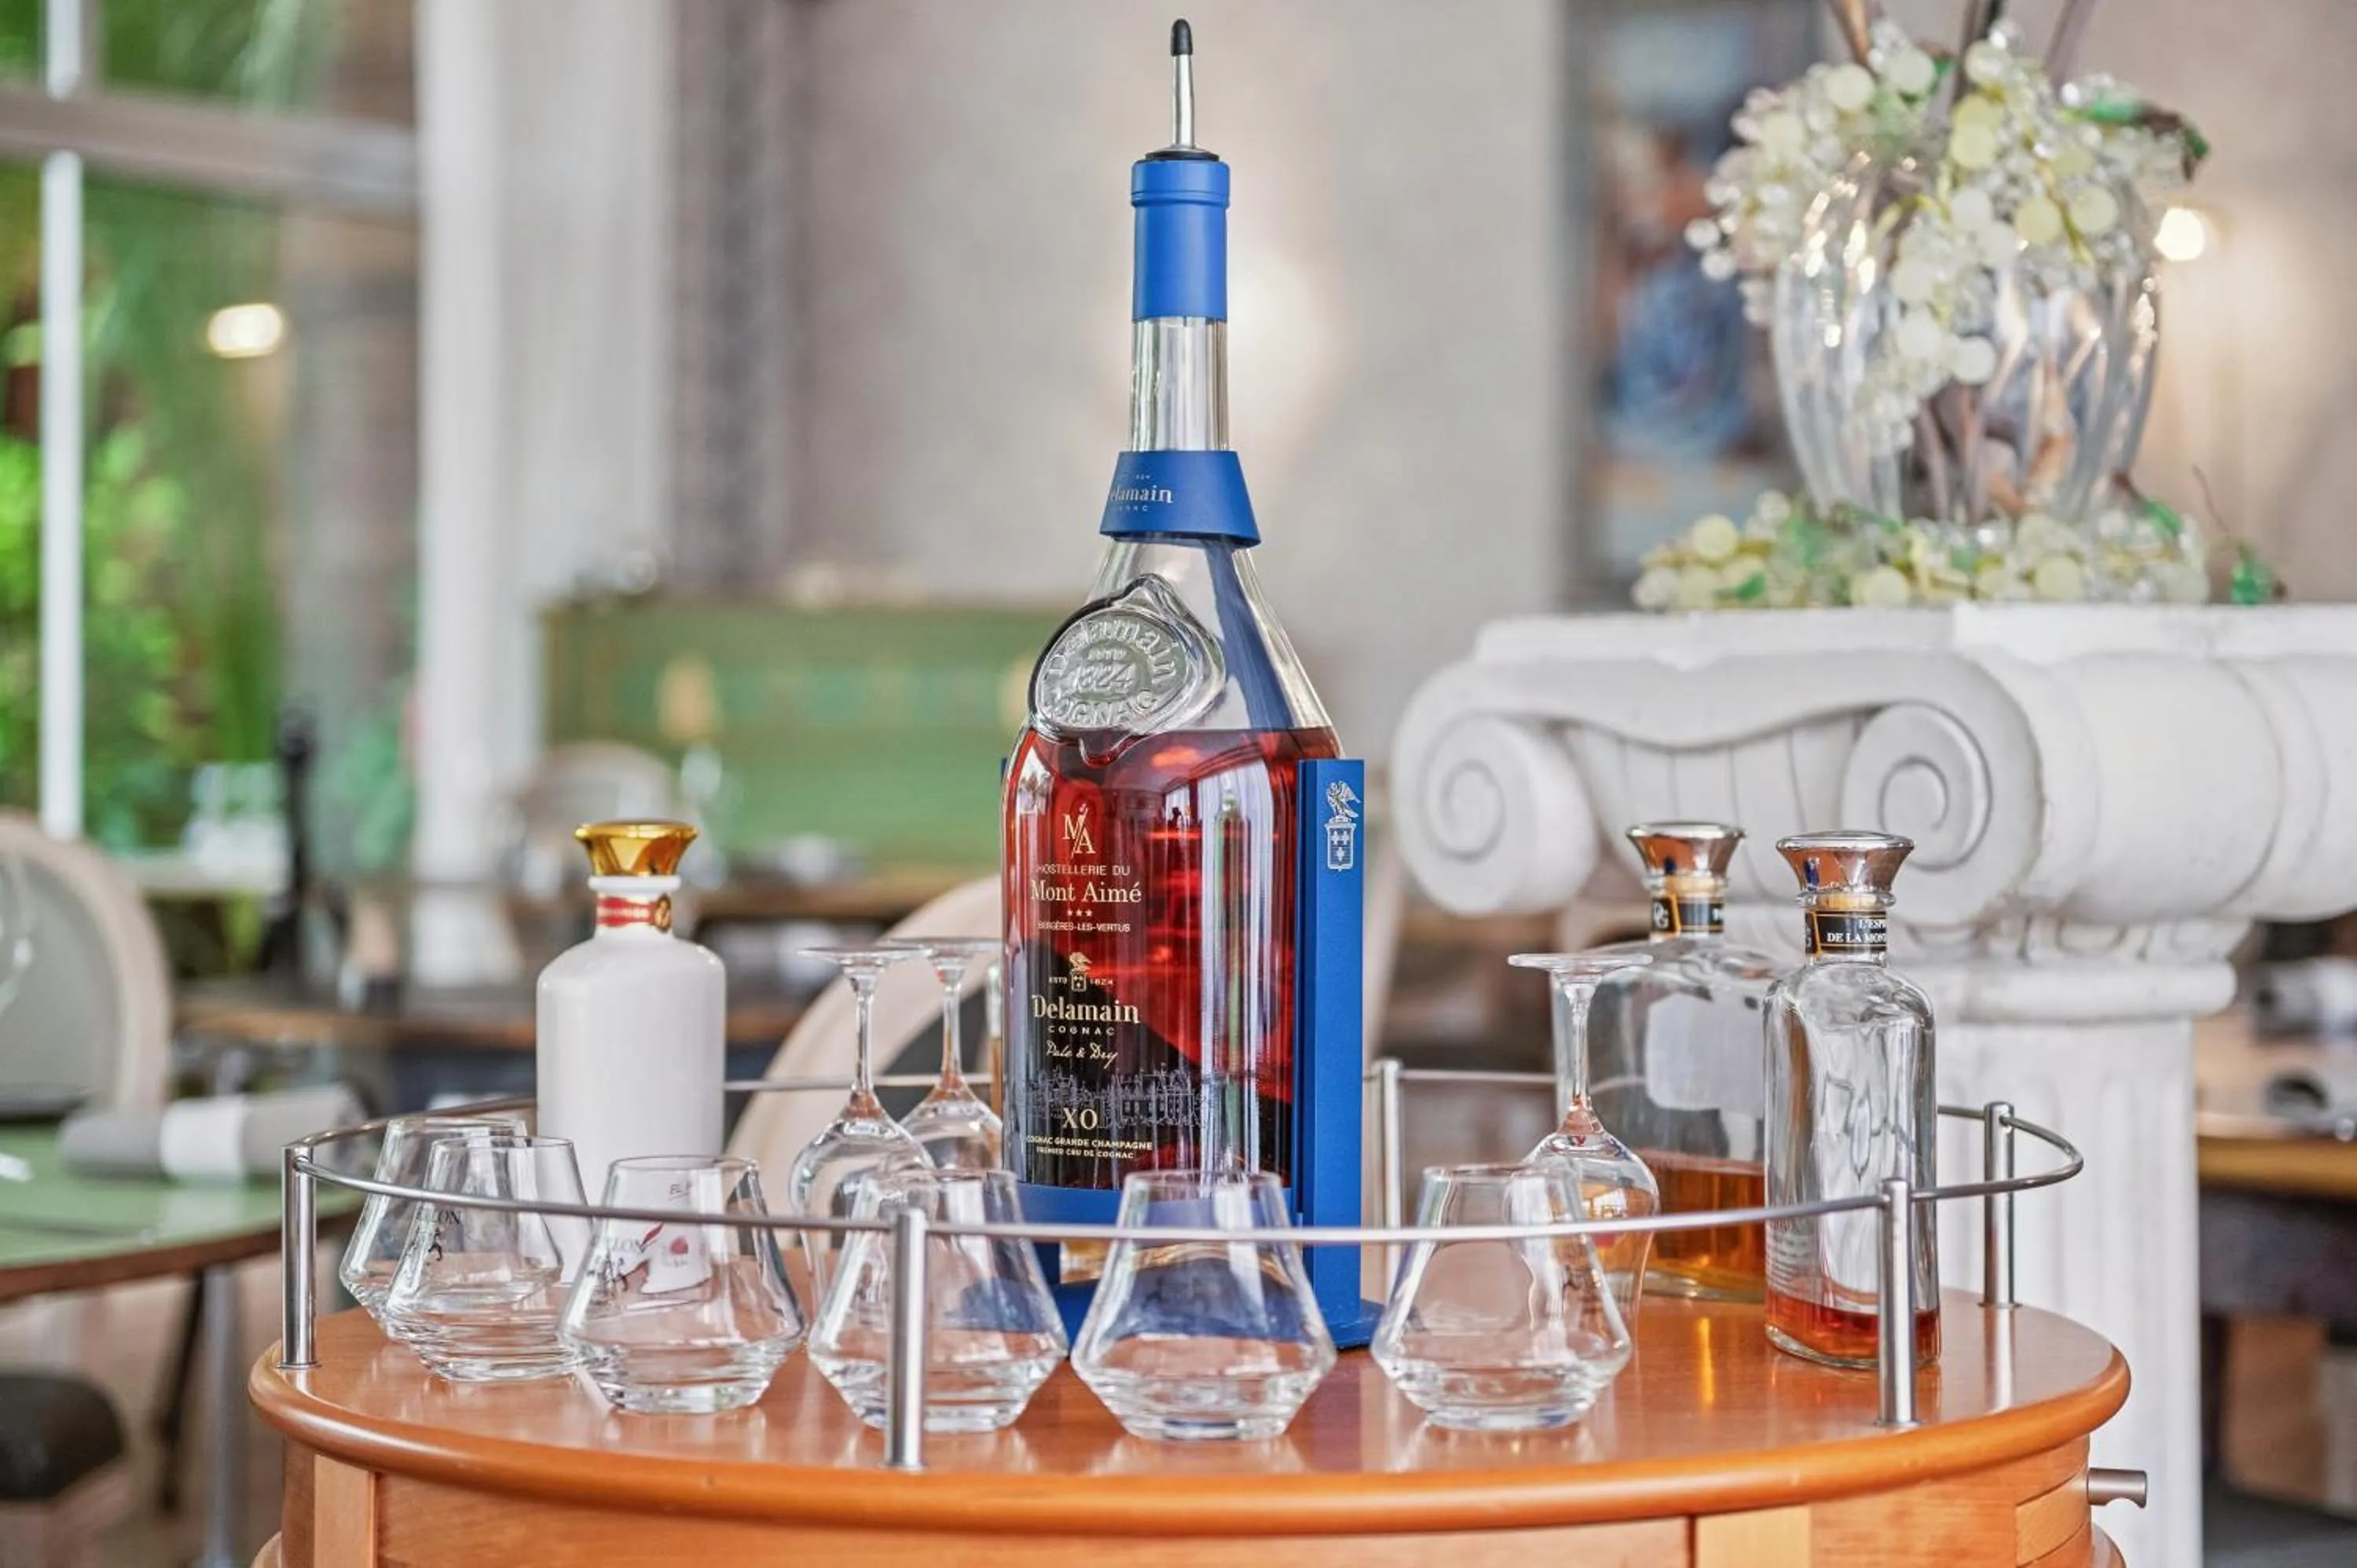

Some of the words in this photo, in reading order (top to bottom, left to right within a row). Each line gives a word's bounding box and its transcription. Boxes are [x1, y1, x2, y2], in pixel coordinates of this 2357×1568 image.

[1113, 865, 1131, 876] DU
[1031, 879, 1076, 901] Mont
[1081, 881, 1142, 903] Aimé
[1827, 932, 1844, 942] DE
[1846, 933, 1862, 943] LA
[1031, 994, 1141, 1024] Delamain
[1048, 1025, 1116, 1035] COGNAC
[1046, 1039, 1073, 1057] Pale
[1076, 1047, 1086, 1058] &
[1090, 1042, 1119, 1069] Dry
[1063, 1107, 1098, 1130] XO
[1027, 1134, 1054, 1145] COGNAC
[1054, 1137, 1090, 1147] GRANDE
[1091, 1139, 1153, 1151] CHAMPAGNE
[1066, 1148, 1082, 1156] CRU
[1084, 1149, 1094, 1157] DE
[1097, 1150, 1135, 1159] COGNAC
